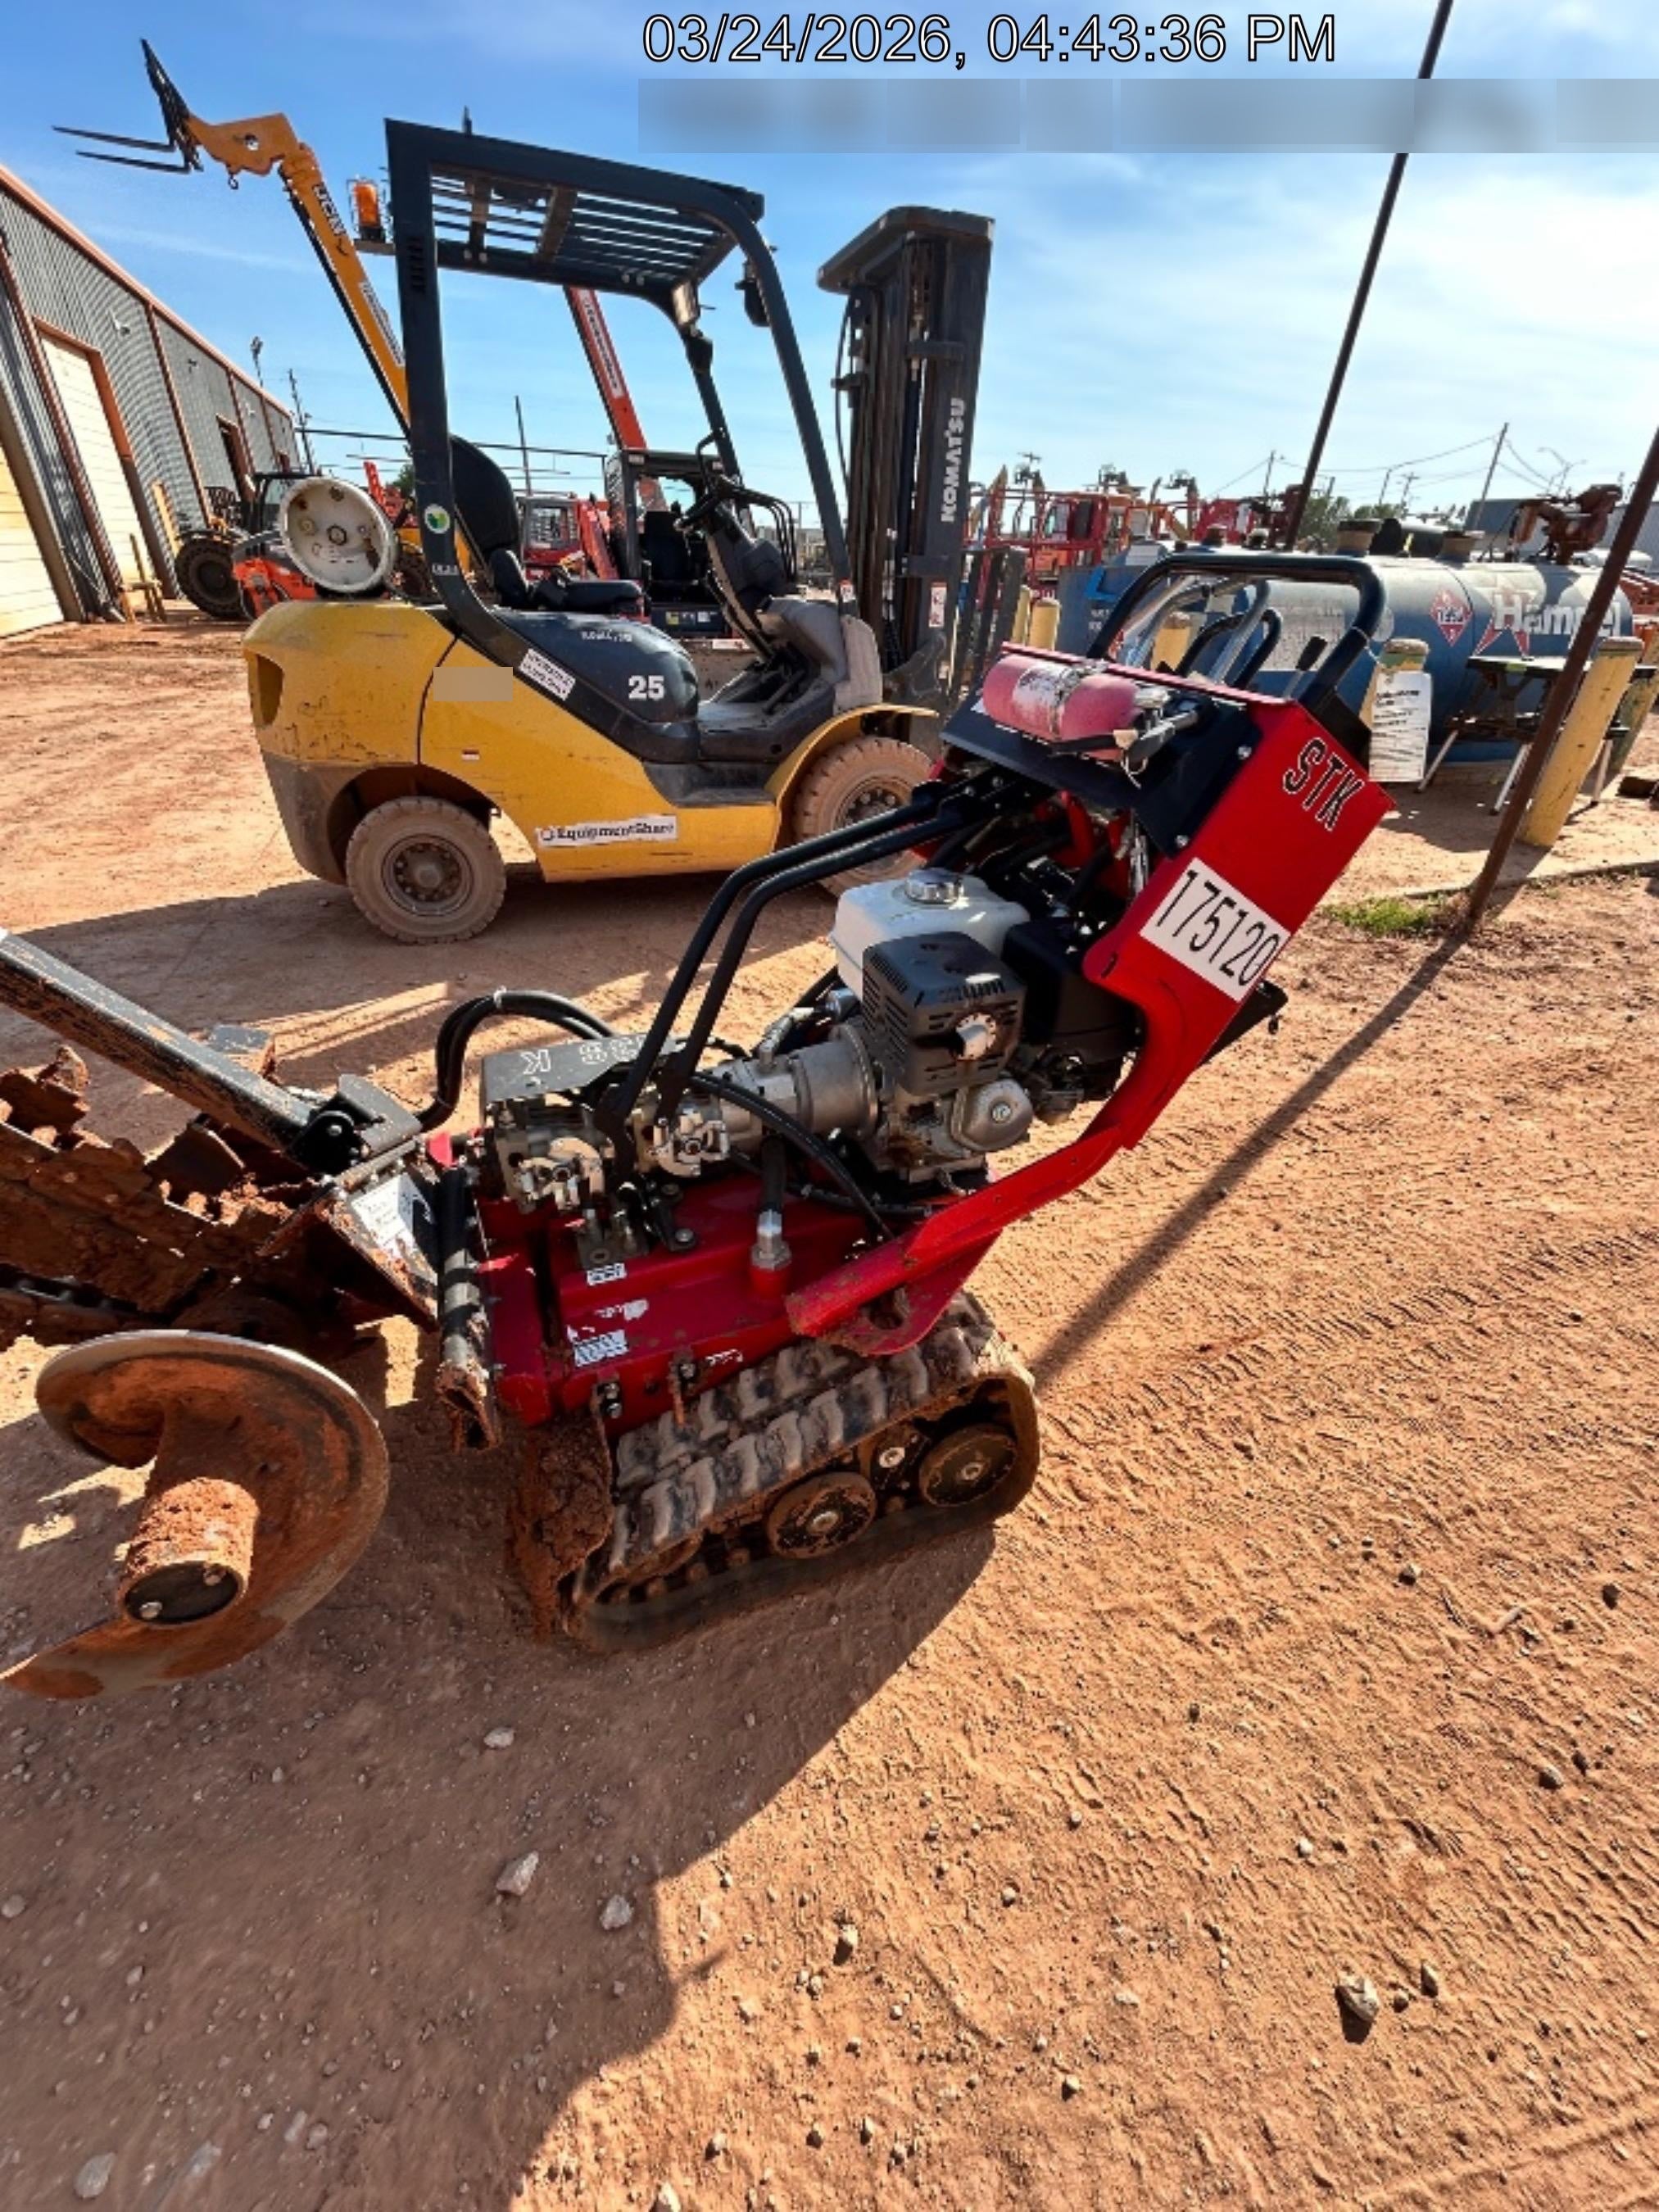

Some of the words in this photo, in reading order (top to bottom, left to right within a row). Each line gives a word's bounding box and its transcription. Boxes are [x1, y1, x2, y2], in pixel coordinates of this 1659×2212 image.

[941, 397, 965, 523] KOMATSU
[628, 675, 664, 700] 25
[1282, 737, 1366, 832] STK
[1156, 869, 1281, 986] 175120
